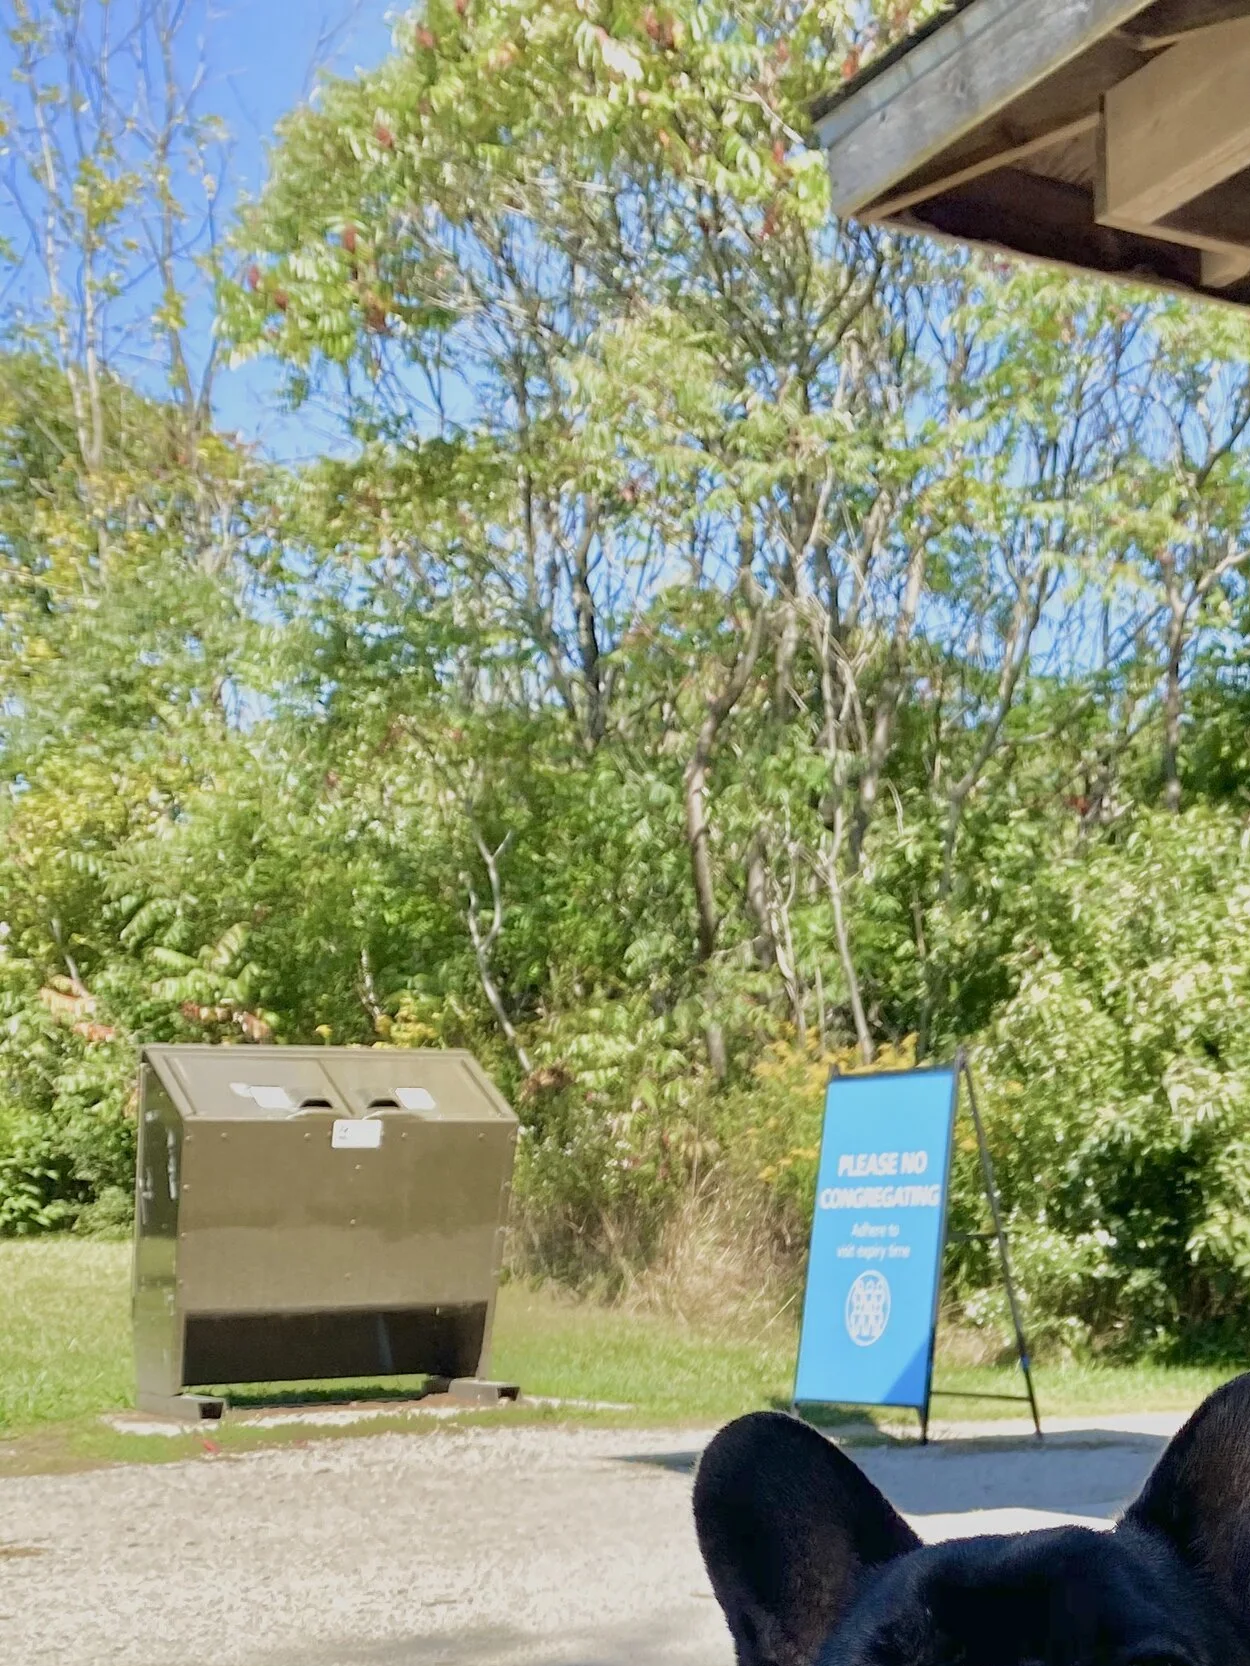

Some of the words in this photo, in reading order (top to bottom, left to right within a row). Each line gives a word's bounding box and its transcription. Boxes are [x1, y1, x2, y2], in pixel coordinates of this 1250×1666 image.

[837, 1152, 898, 1177] PLEASE
[900, 1150, 928, 1174] NO
[820, 1184, 940, 1209] CONGREGATING
